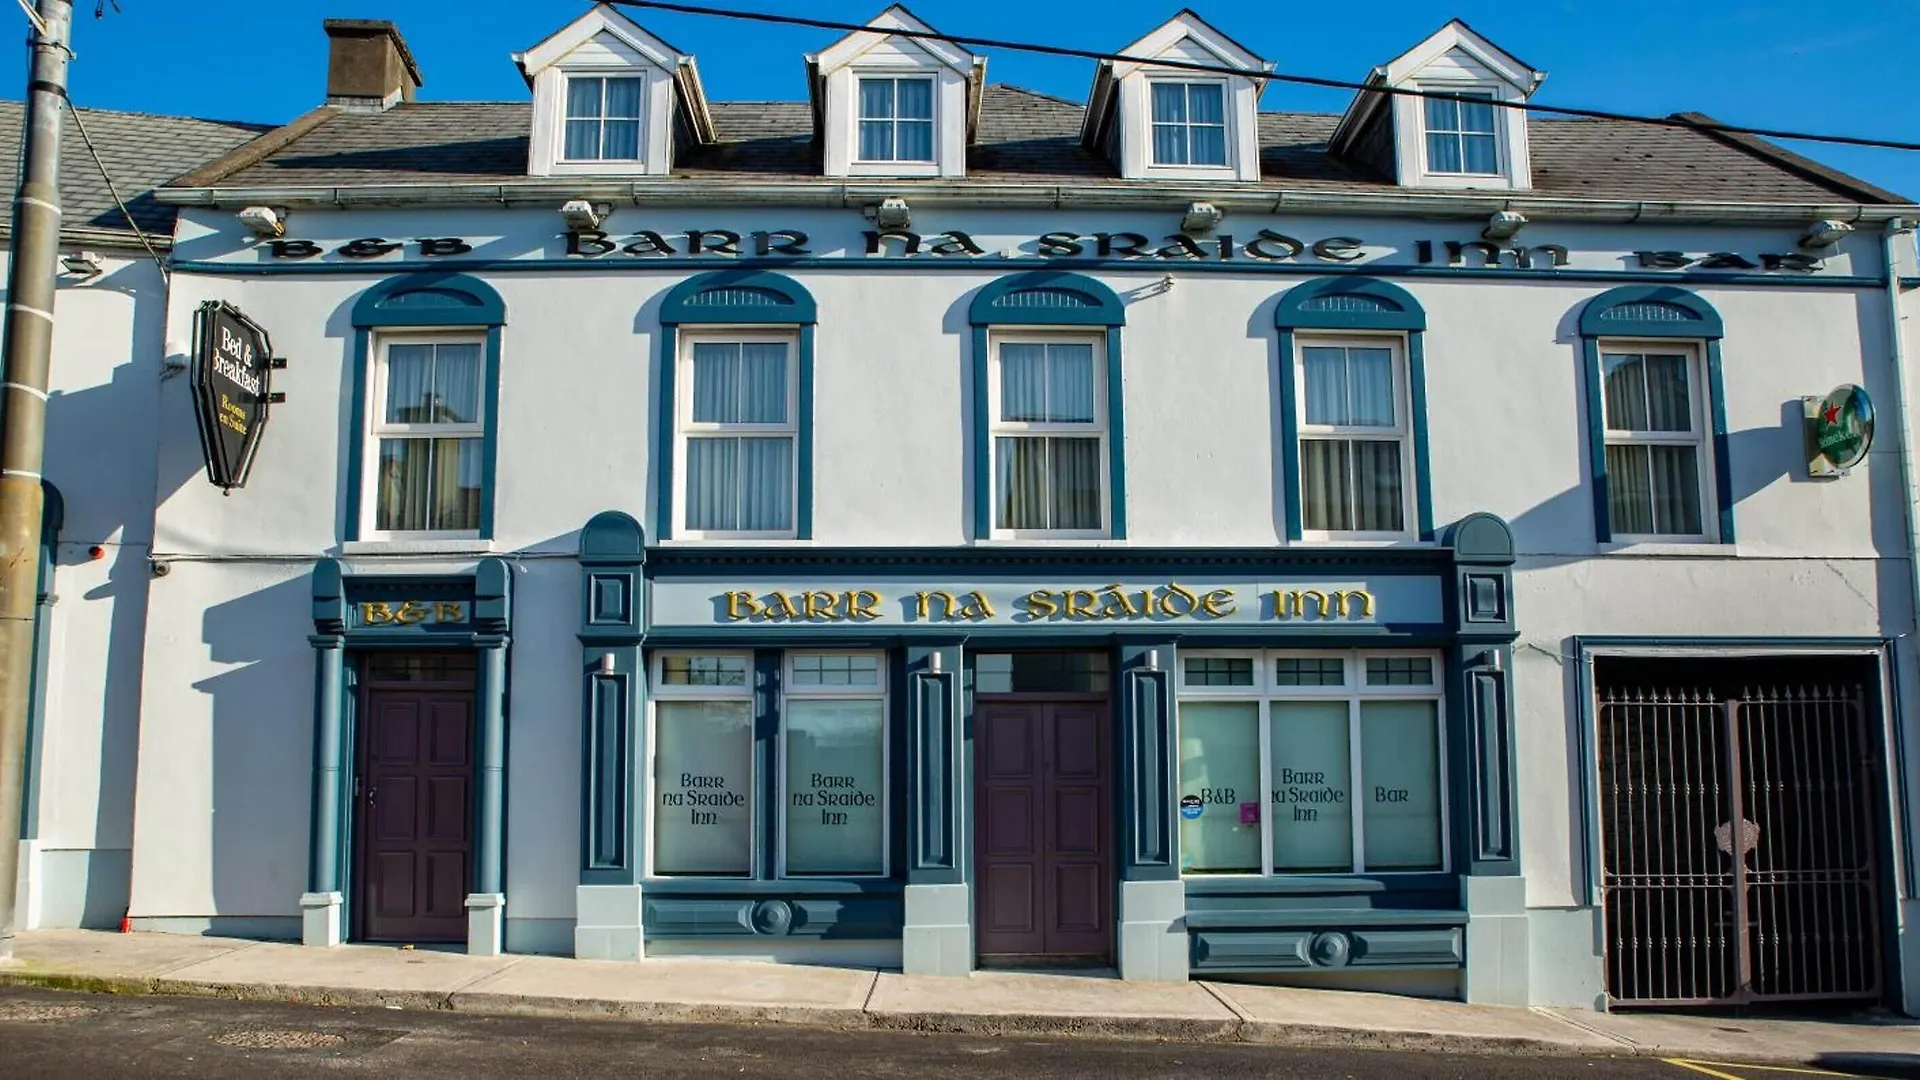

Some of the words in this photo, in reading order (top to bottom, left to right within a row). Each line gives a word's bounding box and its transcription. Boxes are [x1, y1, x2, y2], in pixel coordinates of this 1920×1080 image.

[266, 238, 473, 257] B&B
[222, 326, 242, 360] Bed
[244, 344, 252, 367] &
[213, 348, 260, 397] Breakfast
[363, 600, 465, 624] B&B
[662, 794, 683, 806] na
[793, 793, 813, 806] na
[1201, 788, 1236, 804] B&B
[691, 809, 718, 825] Inn
[822, 809, 848, 825] Inn
[1293, 805, 1317, 821] Inn
